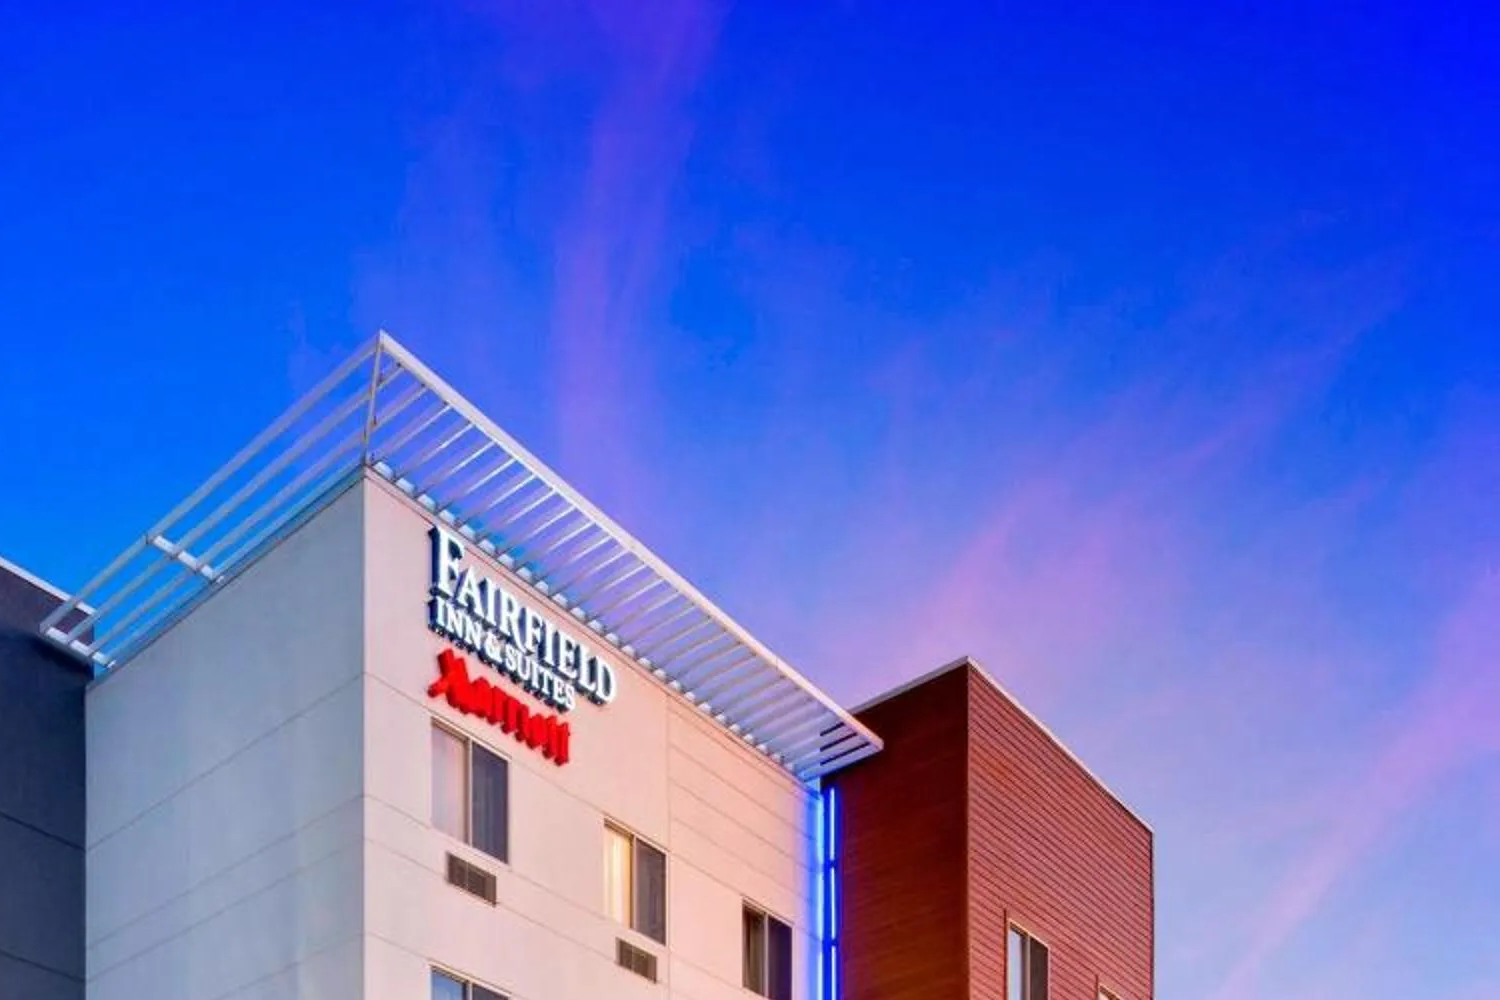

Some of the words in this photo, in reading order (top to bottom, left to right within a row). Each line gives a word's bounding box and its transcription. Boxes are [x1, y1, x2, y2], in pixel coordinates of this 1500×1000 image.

[428, 525, 618, 706] FAIRFIELD
[428, 594, 483, 655] INN
[480, 630, 503, 674] &
[501, 642, 576, 714] SUITES
